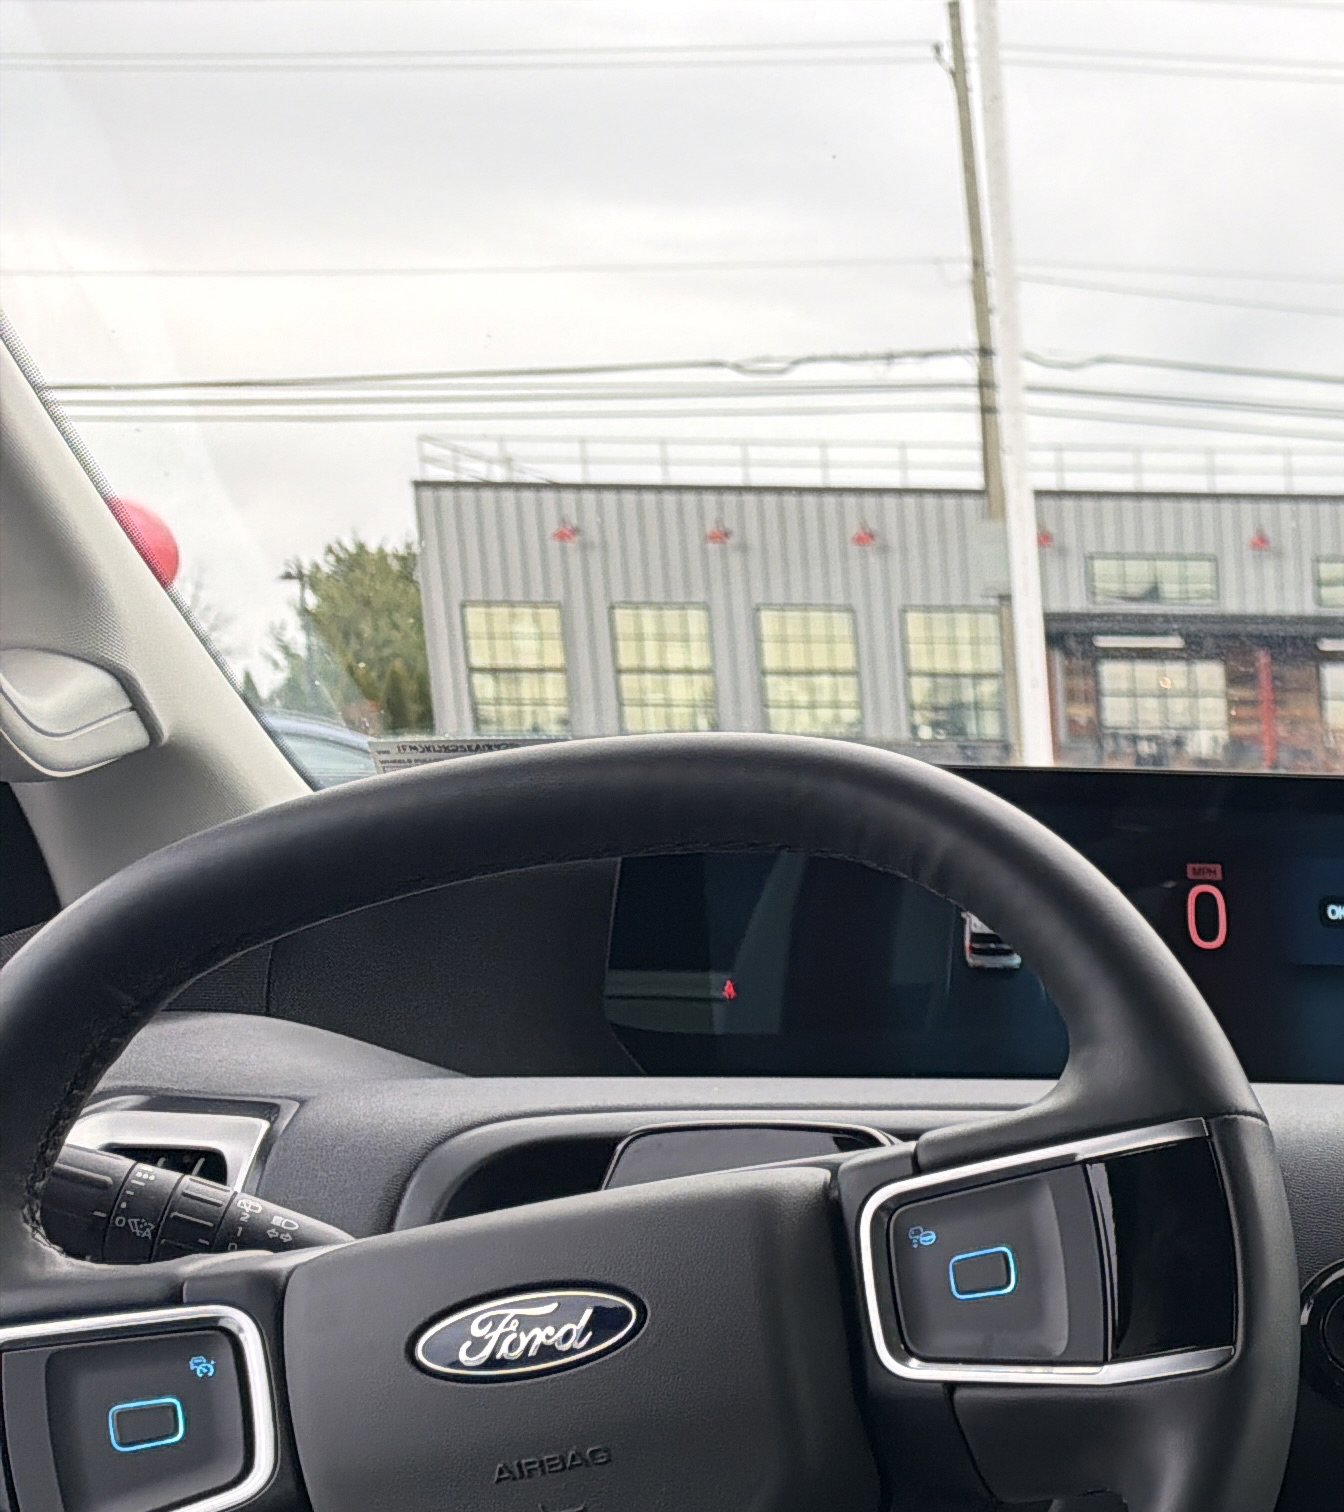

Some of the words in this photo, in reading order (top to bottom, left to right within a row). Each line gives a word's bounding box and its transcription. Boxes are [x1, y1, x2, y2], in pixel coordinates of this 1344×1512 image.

[1187, 883, 1228, 951] 0
[457, 1300, 595, 1368] Ford
[493, 1446, 614, 1486] AIRBAG
